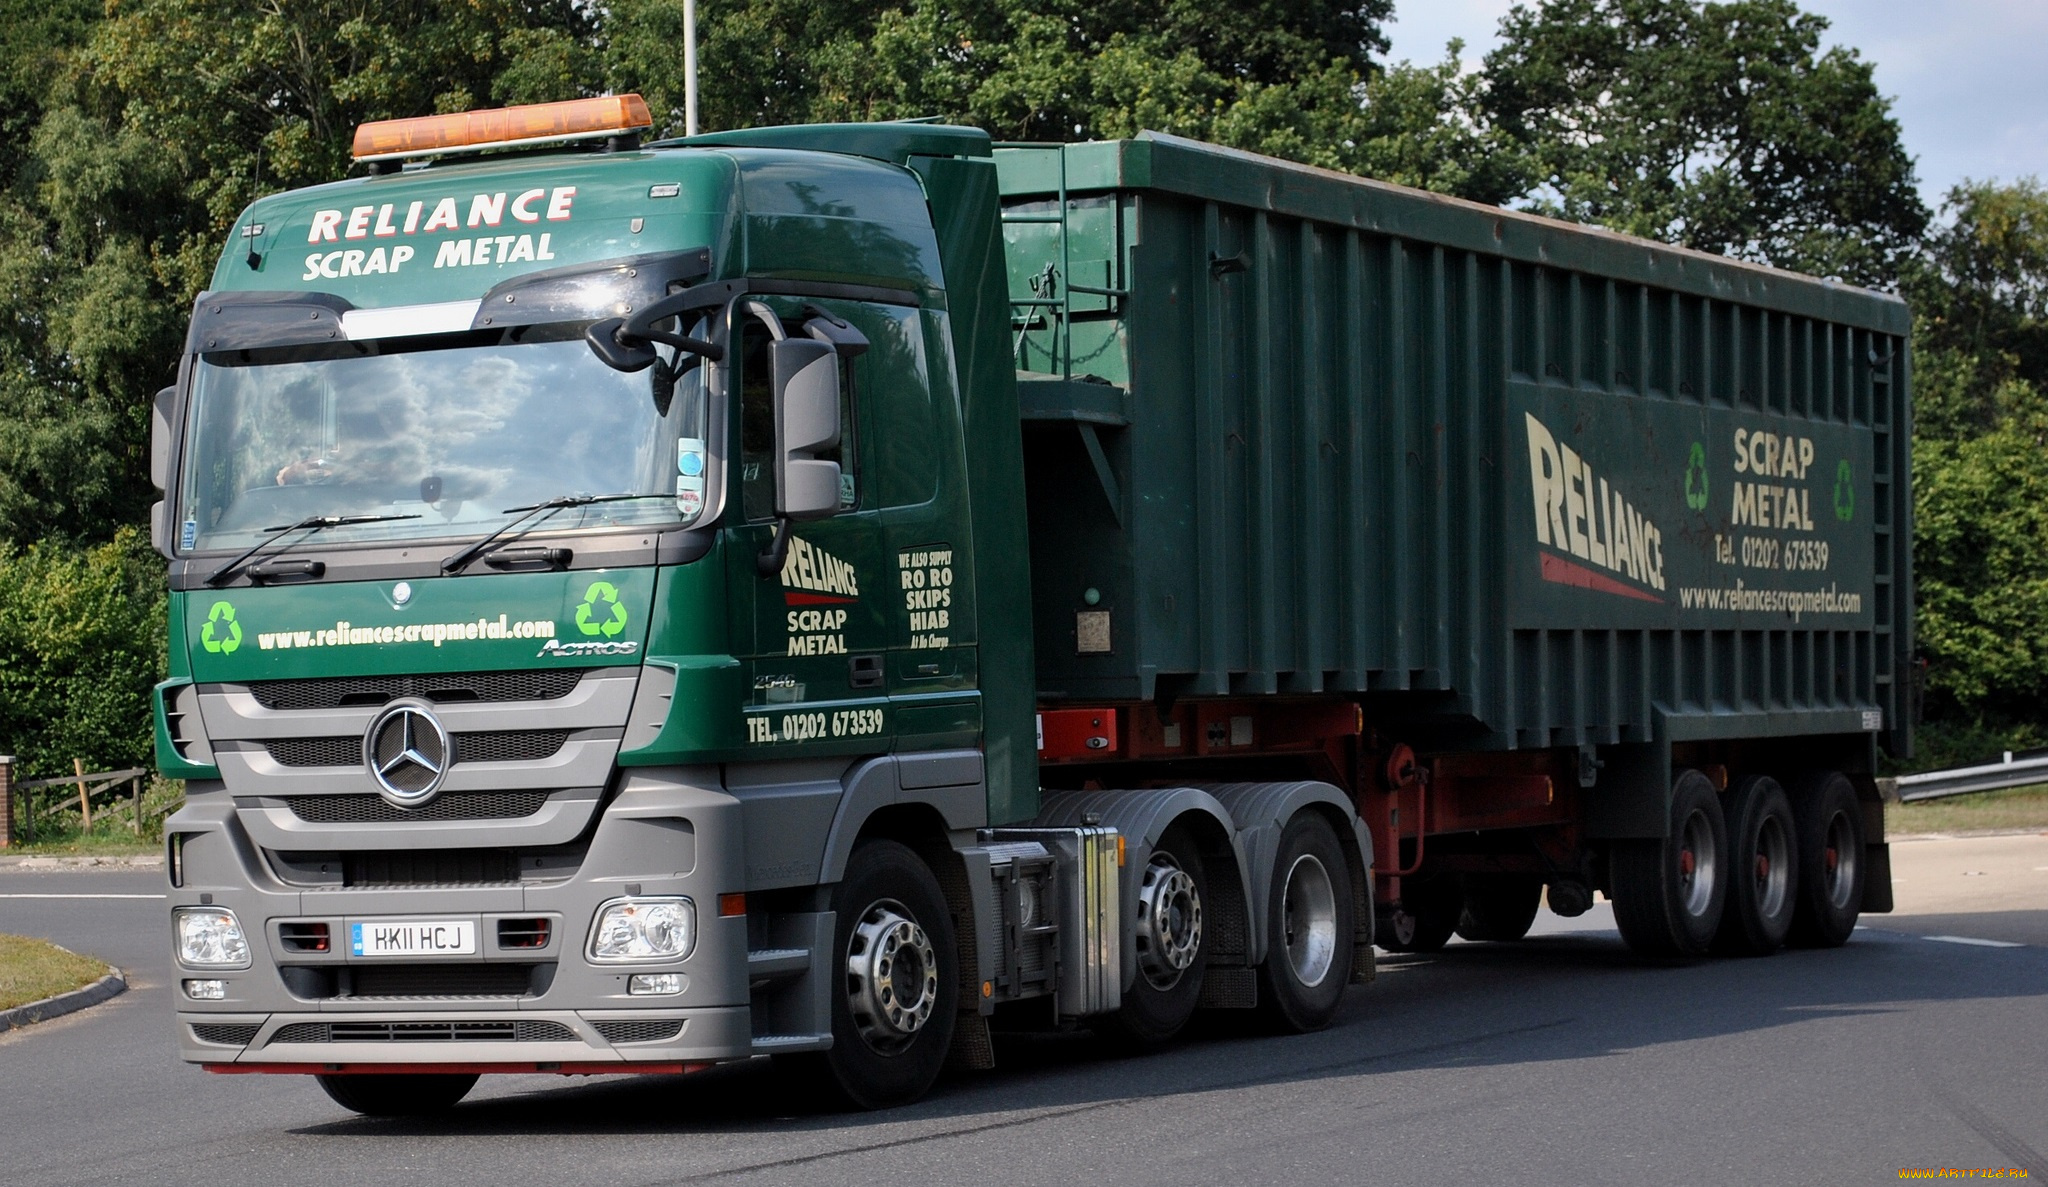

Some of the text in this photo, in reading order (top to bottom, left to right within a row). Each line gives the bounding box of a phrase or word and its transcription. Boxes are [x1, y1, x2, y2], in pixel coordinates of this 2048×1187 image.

[307, 186, 578, 244] RELIANCE
[302, 232, 555, 282] SCRAP METAL
[1733, 427, 1815, 480] SCRAP
[1525, 411, 1666, 591] RELIANCE
[1731, 481, 1815, 532] METAL
[899, 550, 952, 568] WE ALSO SUPPLY
[1714, 533, 1829, 571] Tel. 01202 673539
[901, 567, 953, 589] RO RO
[906, 588, 951, 610] SKIPS
[1680, 577, 1861, 624] www.reliancescrapmetal.com
[258, 614, 555, 650] www.reliancescrapmetal.com
[787, 609, 847, 632] SCRAP
[910, 609, 949, 631] HIAB
[787, 634, 848, 657] METAL
[747, 709, 883, 743] TEL. 01202 673539
[375, 926, 461, 950] HK11 HCJ
